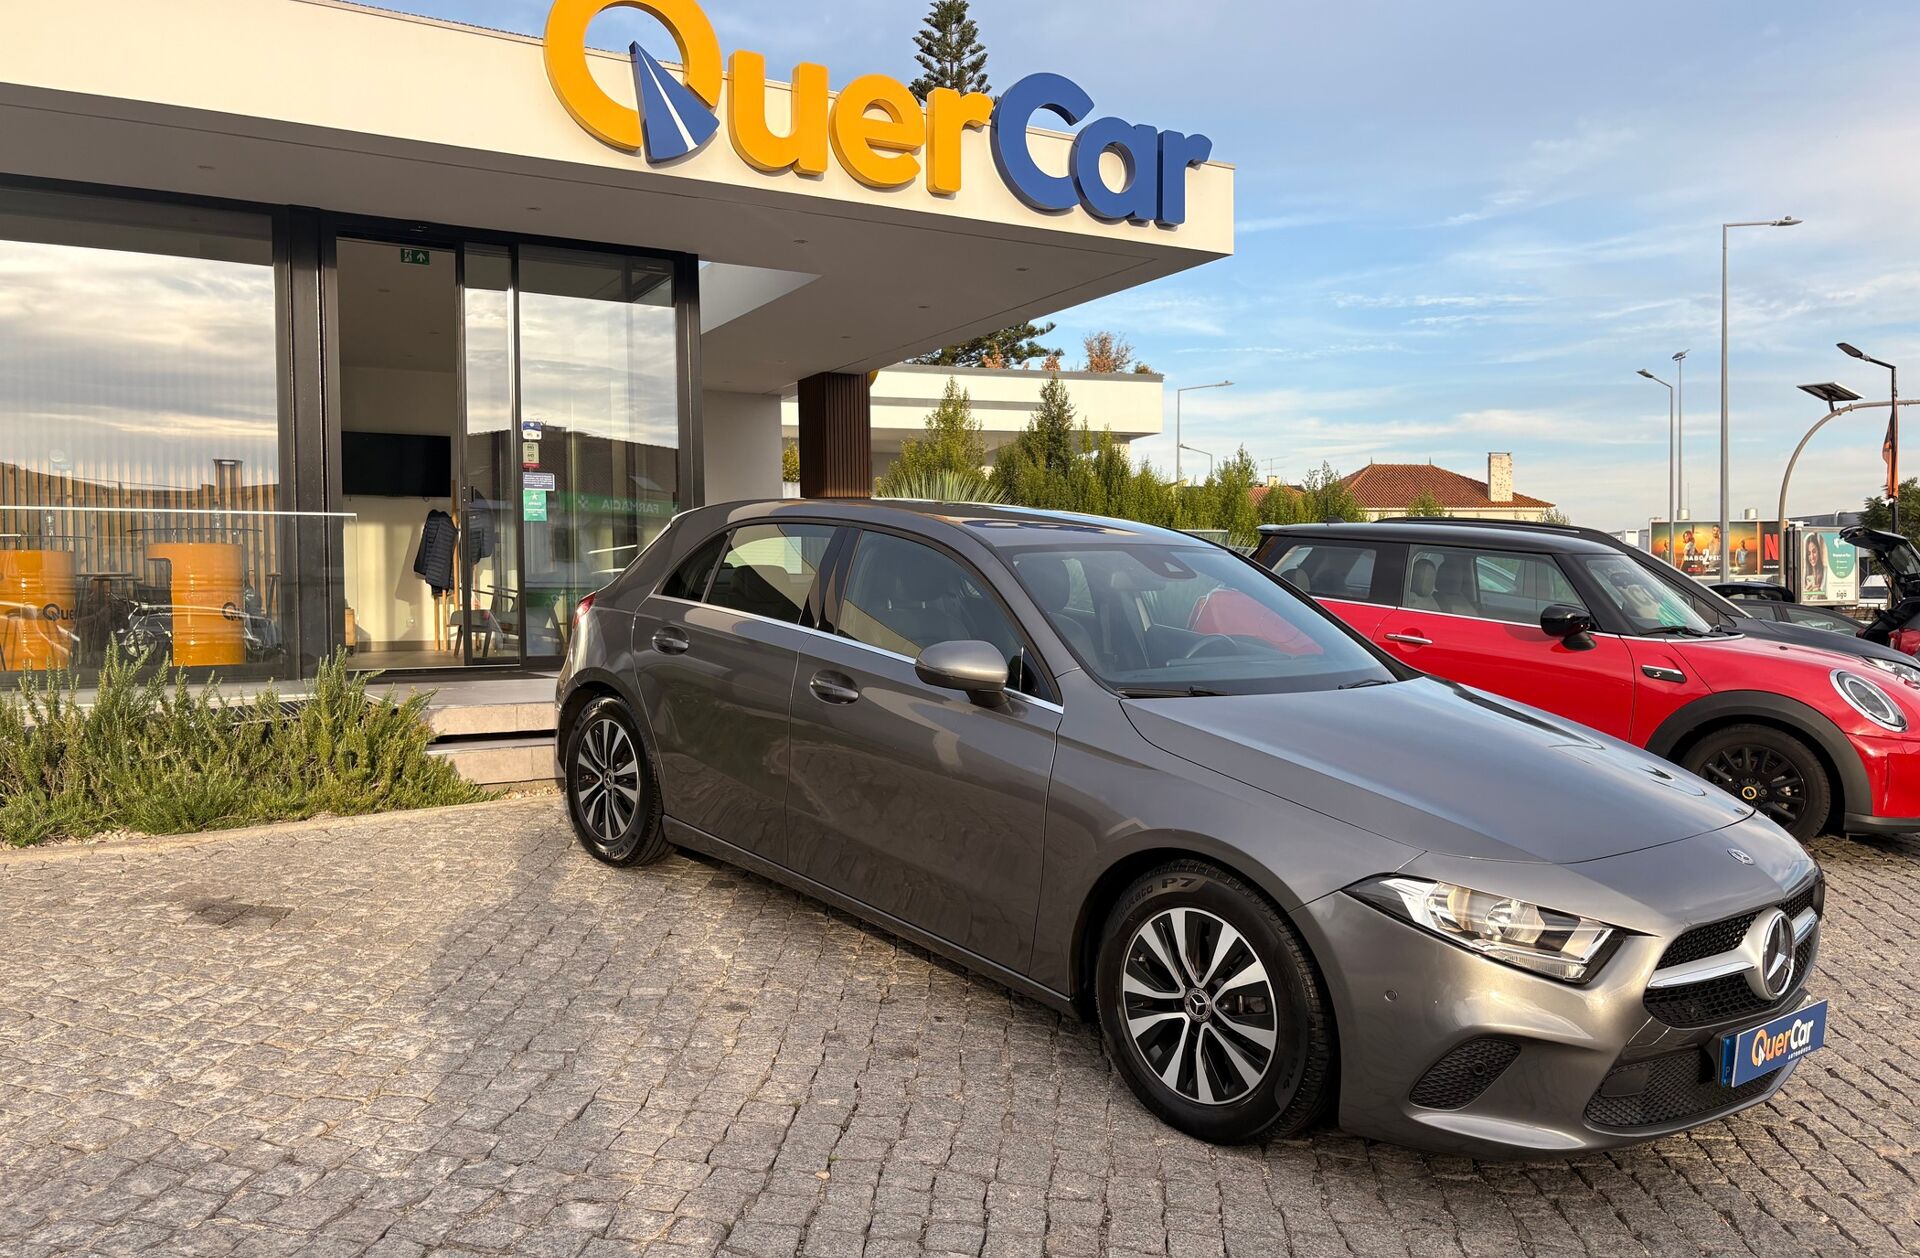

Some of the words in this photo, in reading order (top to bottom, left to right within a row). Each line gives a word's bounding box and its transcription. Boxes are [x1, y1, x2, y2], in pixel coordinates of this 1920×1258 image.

[544, 0, 1214, 229] QuerCar
[1161, 877, 1197, 889] P7
[1751, 1018, 1814, 1067] QuerCar
